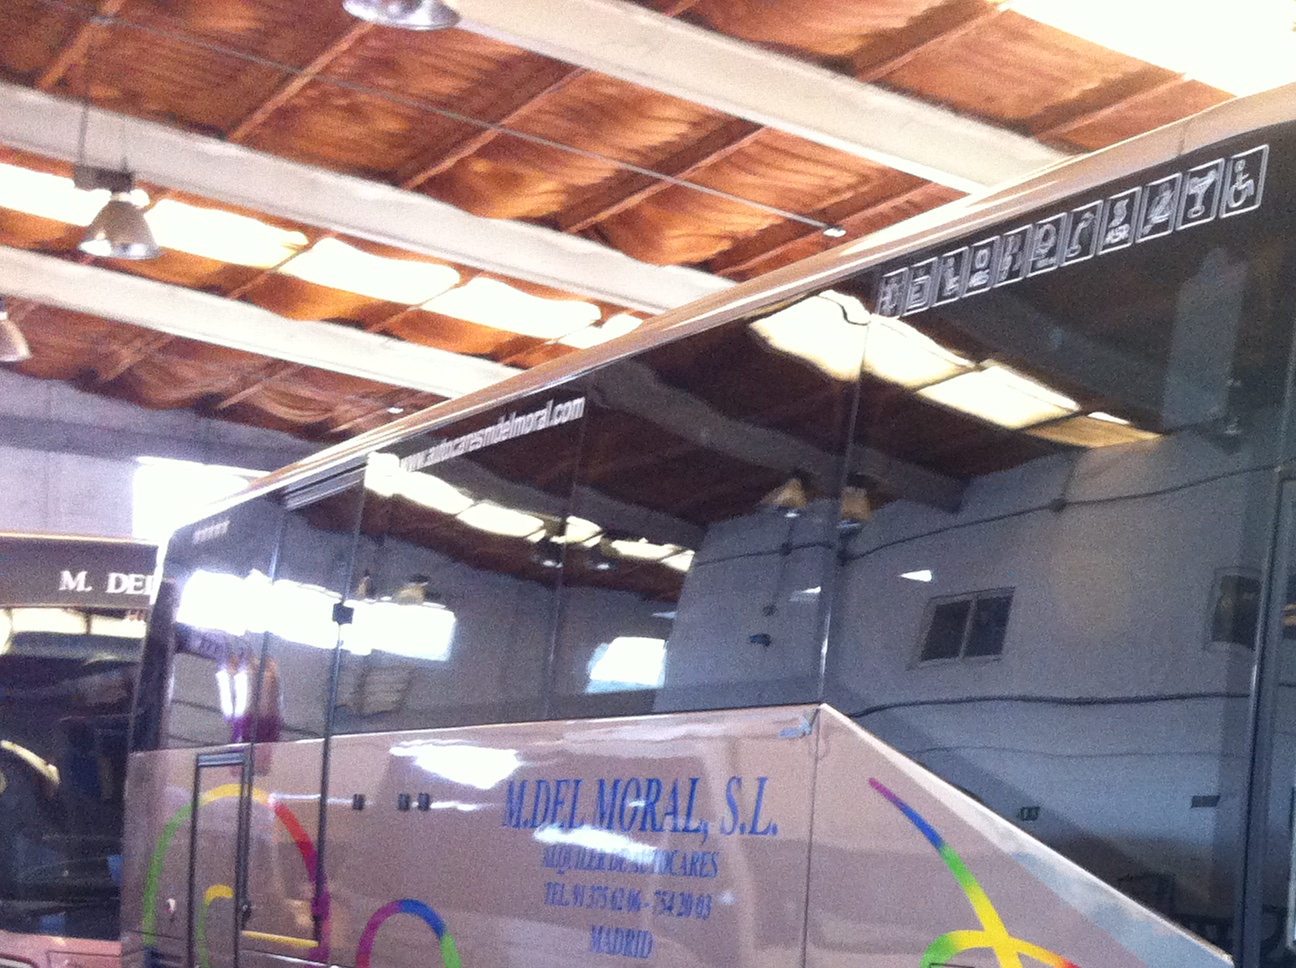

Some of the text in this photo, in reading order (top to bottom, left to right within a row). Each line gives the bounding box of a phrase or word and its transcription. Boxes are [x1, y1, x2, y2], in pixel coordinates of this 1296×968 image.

[593, 776, 711, 845] MORAL,
[719, 775, 780, 837] S.L.
[589, 924, 655, 960] MADRID
